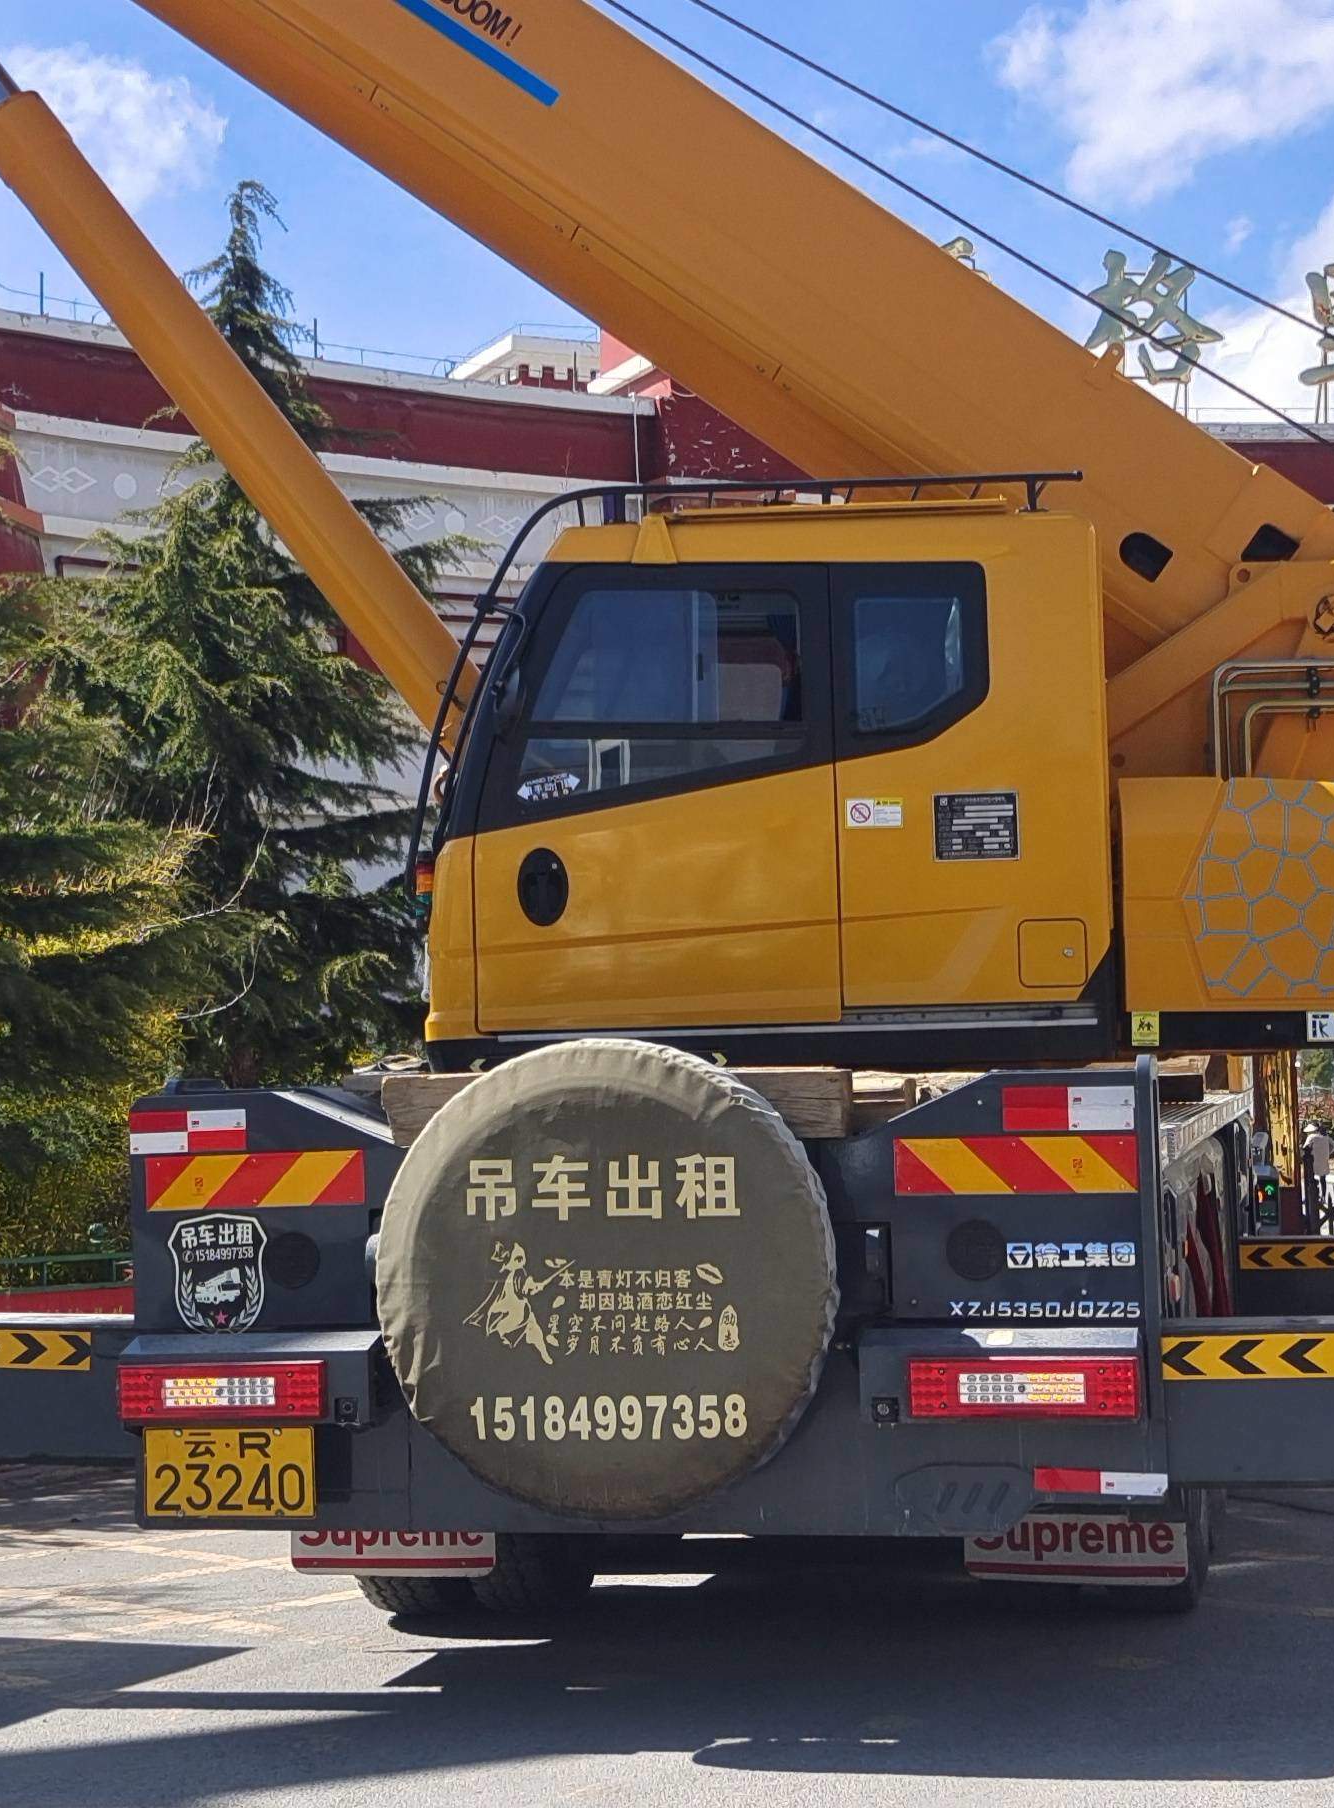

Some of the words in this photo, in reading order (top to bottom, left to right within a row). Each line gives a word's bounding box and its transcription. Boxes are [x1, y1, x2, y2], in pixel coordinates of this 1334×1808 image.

[438, 0, 523, 47] OOM!
[467, 1153, 741, 1221] 吊车出租
[181, 1223, 253, 1249] 吊车出租
[1035, 1242, 1136, 1267] 徐工集团
[558, 1269, 692, 1289] 本是青灯不归客
[579, 1292, 713, 1311] 却因浊酒恋红尘
[548, 1313, 695, 1334] 星空不问赶路人
[565, 1336, 715, 1357] 岁月不负有心人
[470, 1394, 748, 1441] 15184997358
[154, 1463, 305, 1512] 23240
